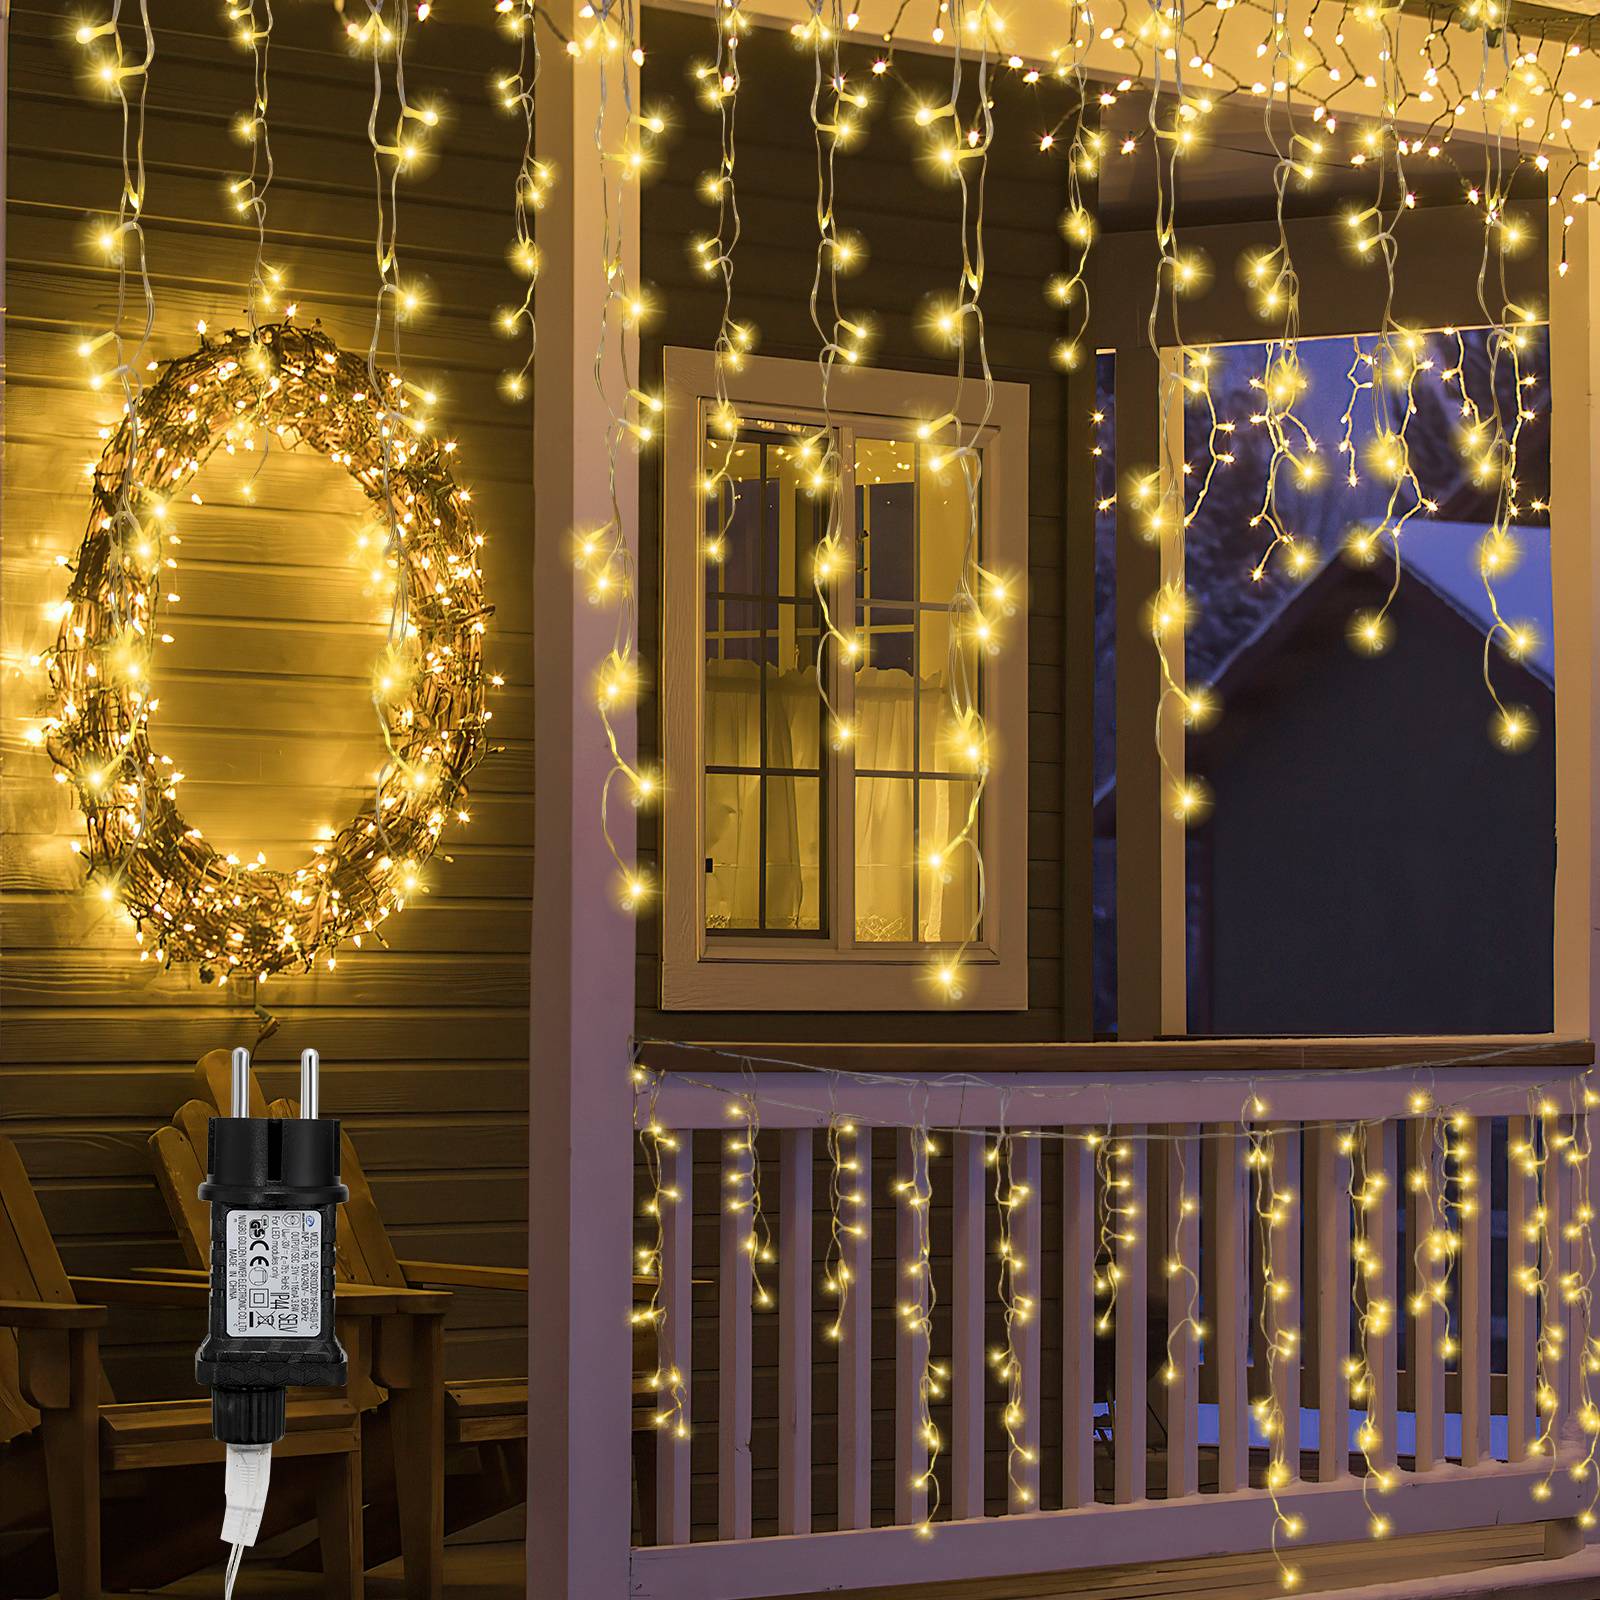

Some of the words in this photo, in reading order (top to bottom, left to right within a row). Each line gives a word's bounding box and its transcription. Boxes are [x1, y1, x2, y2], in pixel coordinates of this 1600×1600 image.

[250, 1221, 265, 1238] GS
[271, 1216, 280, 1226] For
[271, 1227, 280, 1240] LED
[310, 1231, 319, 1249] MODEL
[238, 1236, 247, 1258] GOLDEN
[249, 1240, 269, 1266] CE
[271, 1240, 280, 1265] modules
[229, 1249, 237, 1267] MADE
[238, 1259, 247, 1278] POWER
[270, 1266, 280, 1280] only
[229, 1280, 237, 1301] CHINA
[281, 1276, 290, 1291] RoHS
[238, 1278, 247, 1310] ELECTRONIC
[270, 1292, 290, 1310] IP44
[278, 1313, 298, 1334] SELV
